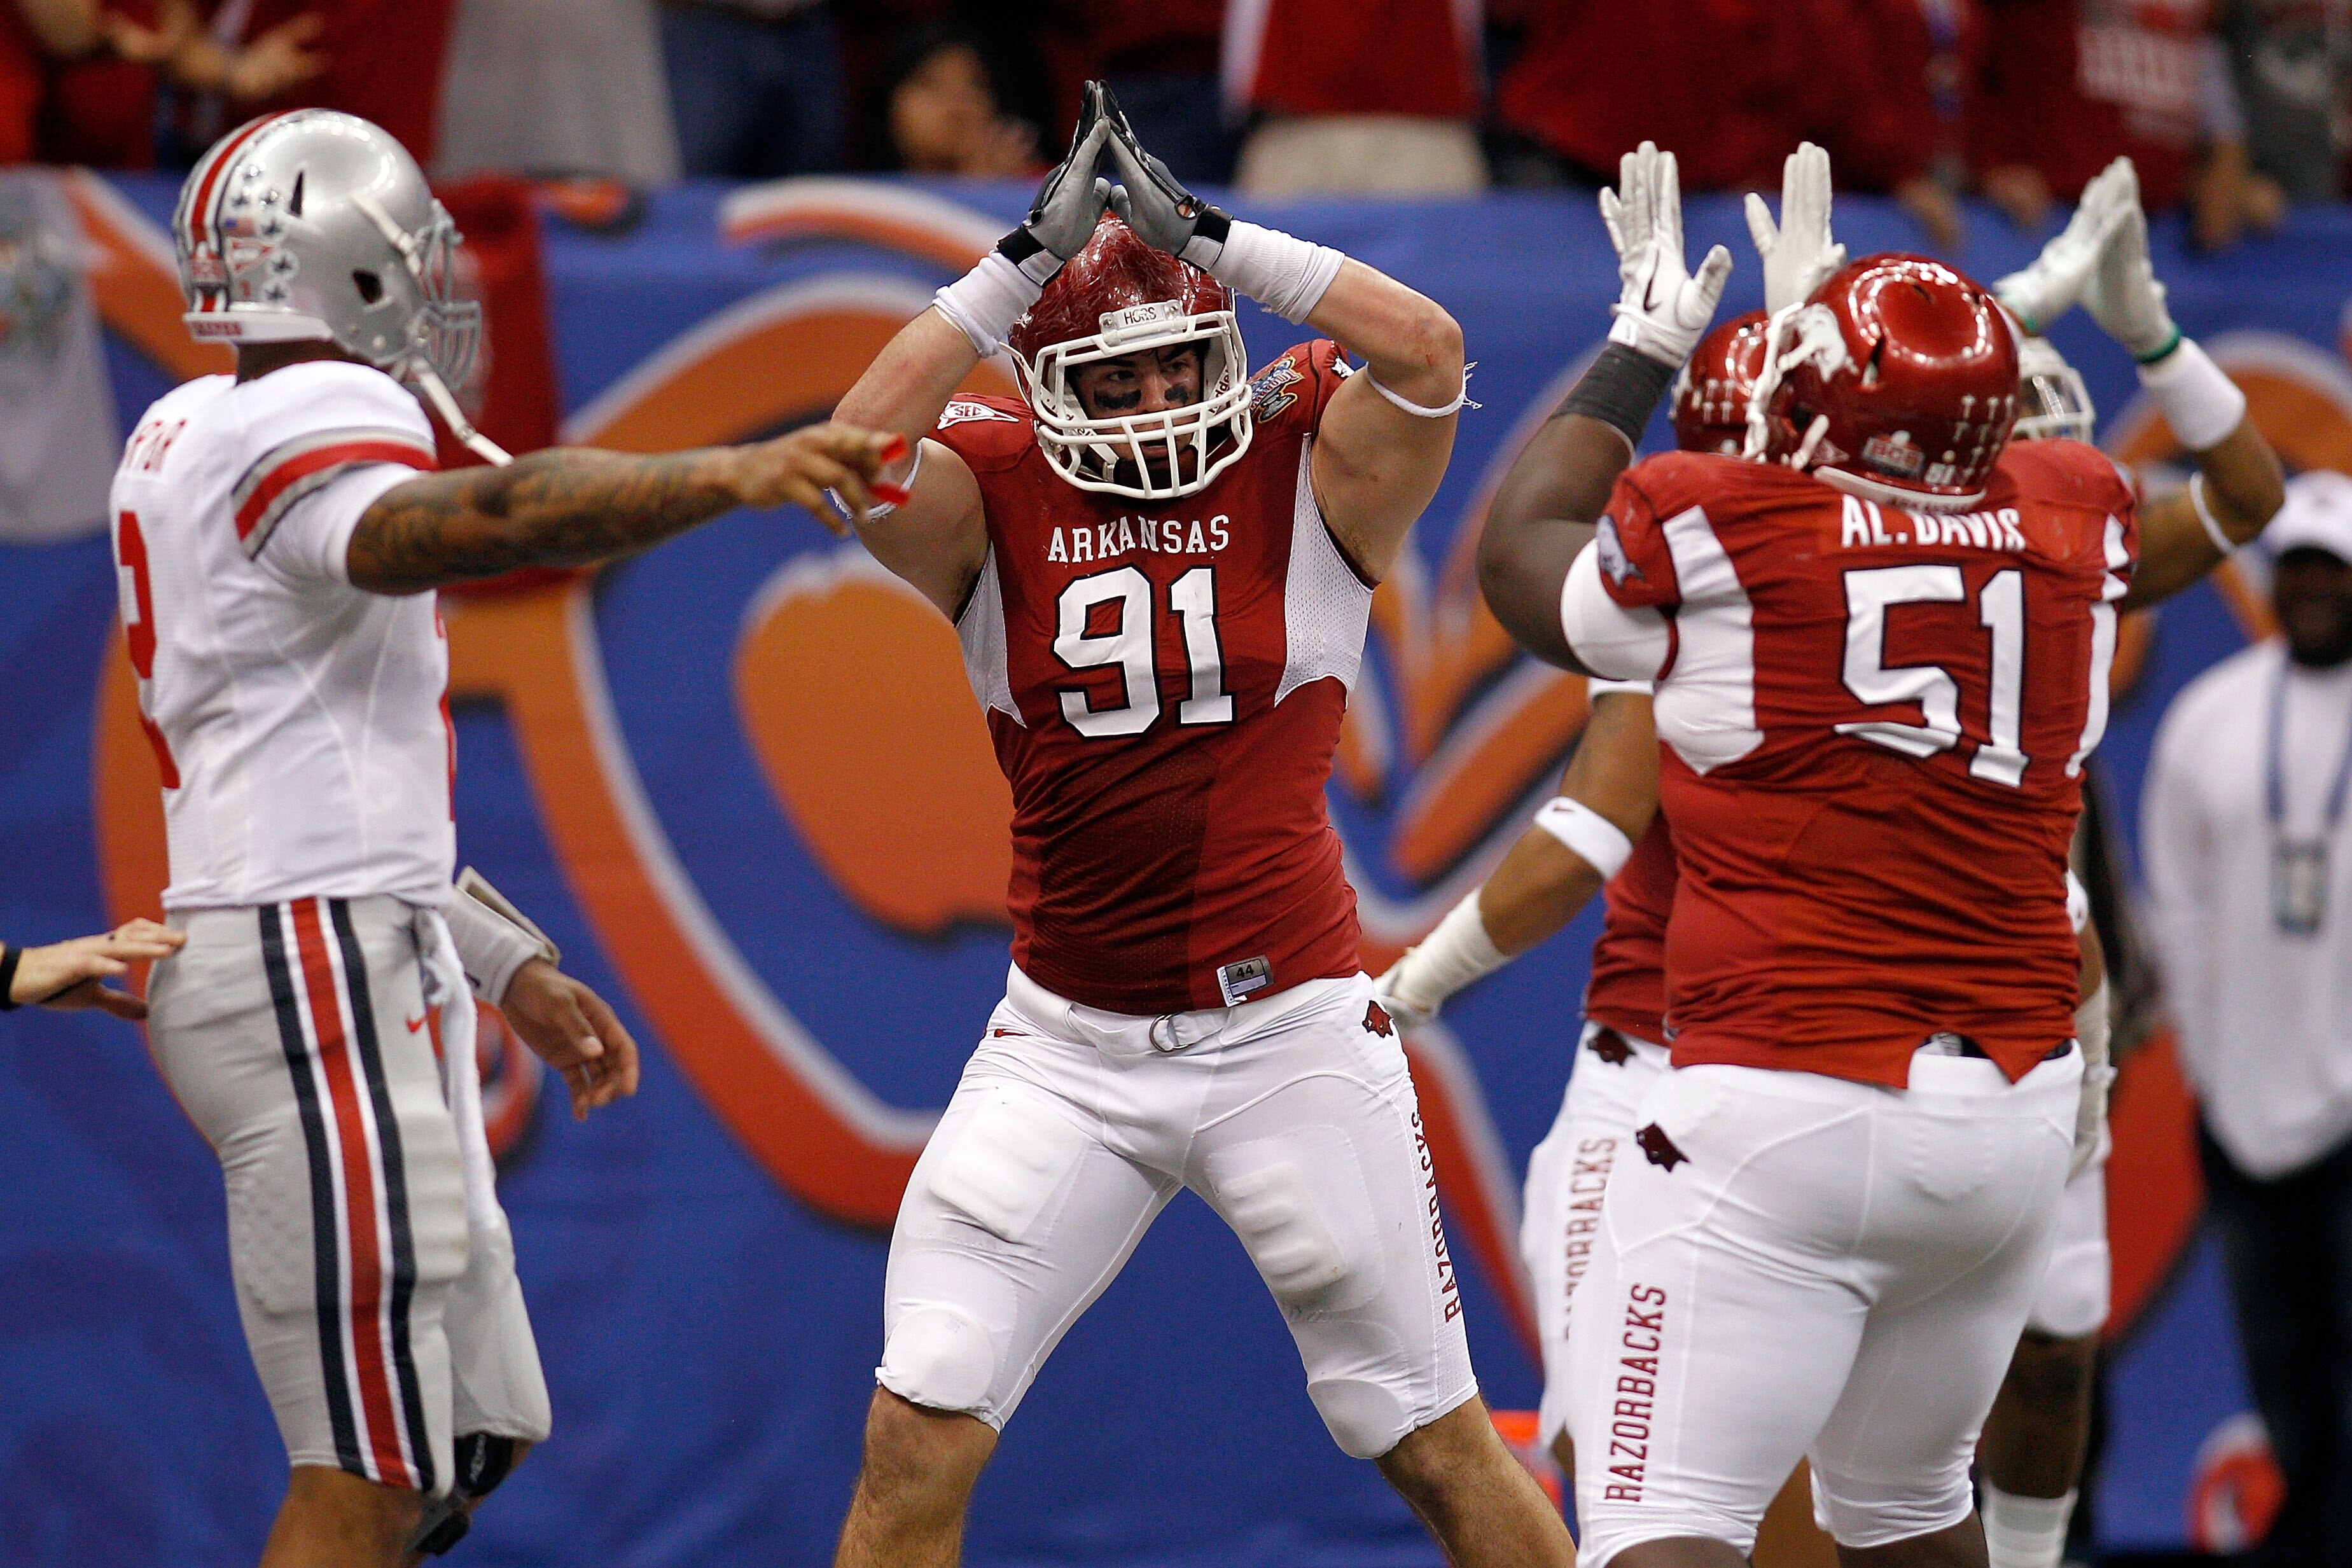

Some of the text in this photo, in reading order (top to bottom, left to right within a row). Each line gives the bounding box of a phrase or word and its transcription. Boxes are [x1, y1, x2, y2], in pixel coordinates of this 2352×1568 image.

[954, 405, 983, 417] SEC
[1048, 515, 1229, 563] ARKANSAS
[1051, 564, 1237, 739] 91
[1834, 564, 2029, 787] 51
[1236, 964, 1254, 978] 44
[1604, 1284, 1667, 1502] RAZORBACKS
